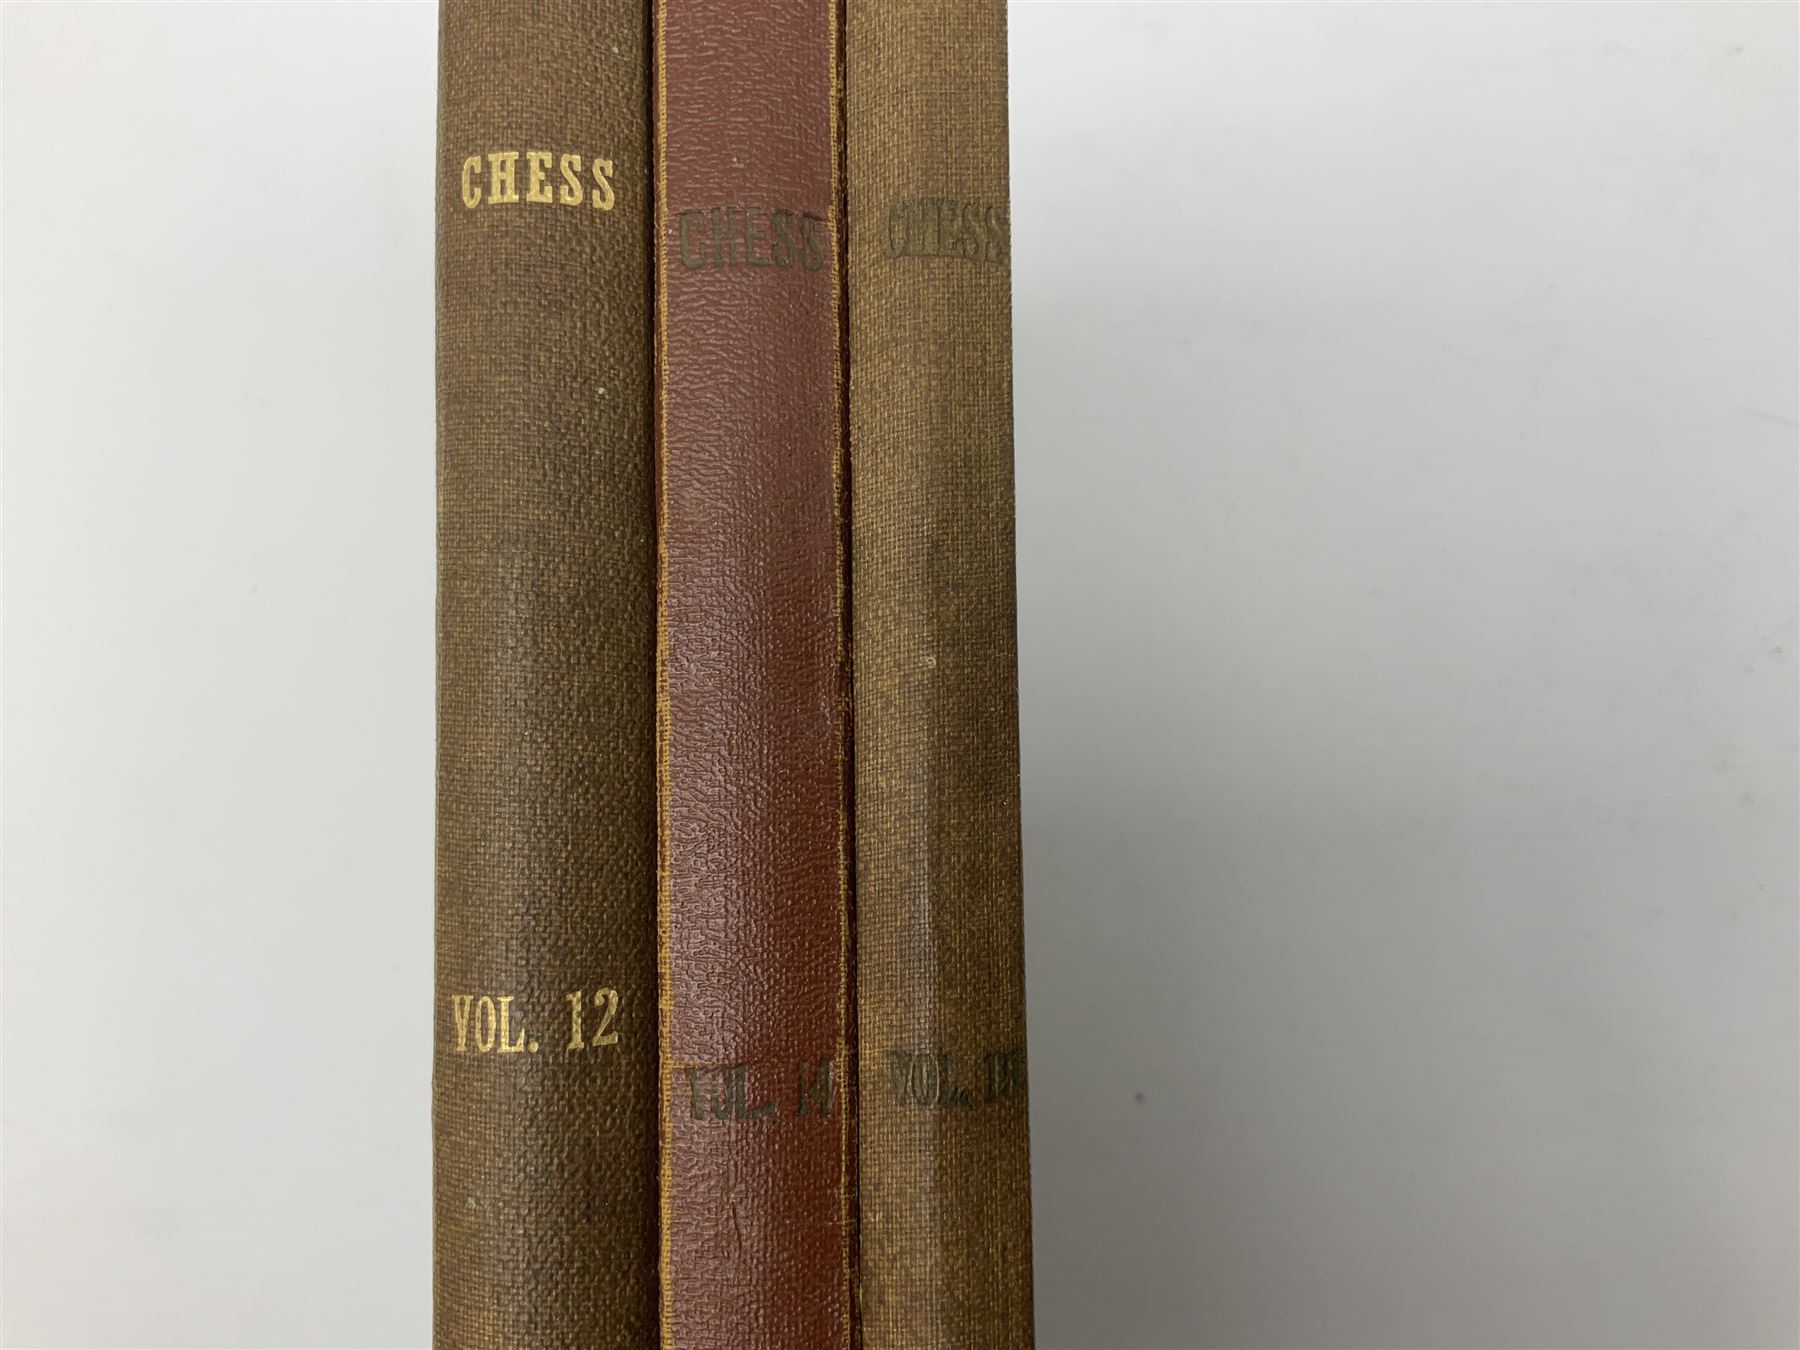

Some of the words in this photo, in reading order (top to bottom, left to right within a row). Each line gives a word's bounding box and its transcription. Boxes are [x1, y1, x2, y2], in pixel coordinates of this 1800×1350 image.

[462, 150, 616, 211] CHESS
[680, 206, 828, 271] CHESS
[887, 197, 1010, 264] CHESS
[452, 994, 539, 1054] VOL.
[566, 986, 619, 1051] 12
